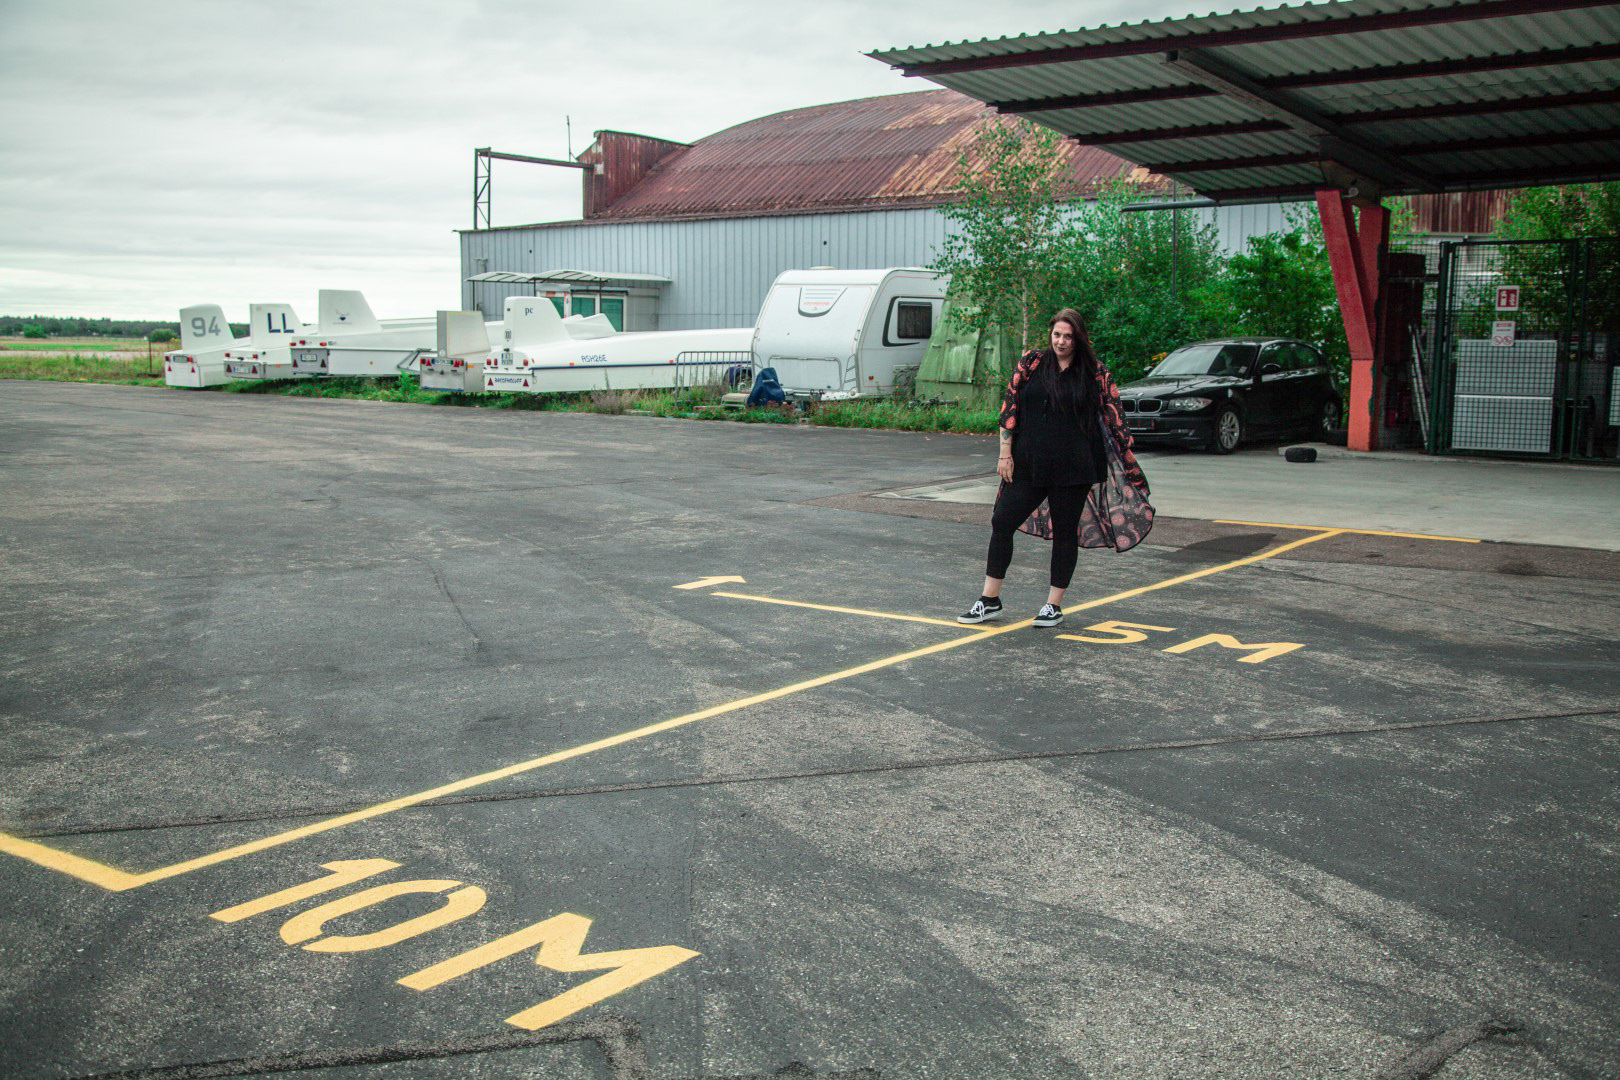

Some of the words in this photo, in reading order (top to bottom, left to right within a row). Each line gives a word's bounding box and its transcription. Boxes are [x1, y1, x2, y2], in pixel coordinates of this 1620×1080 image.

[191, 316, 221, 338] 94
[267, 312, 295, 334] LL
[1055, 620, 1177, 645] 5
[1162, 633, 1306, 664] M
[208, 857, 488, 953] 10
[395, 911, 701, 1032] M
